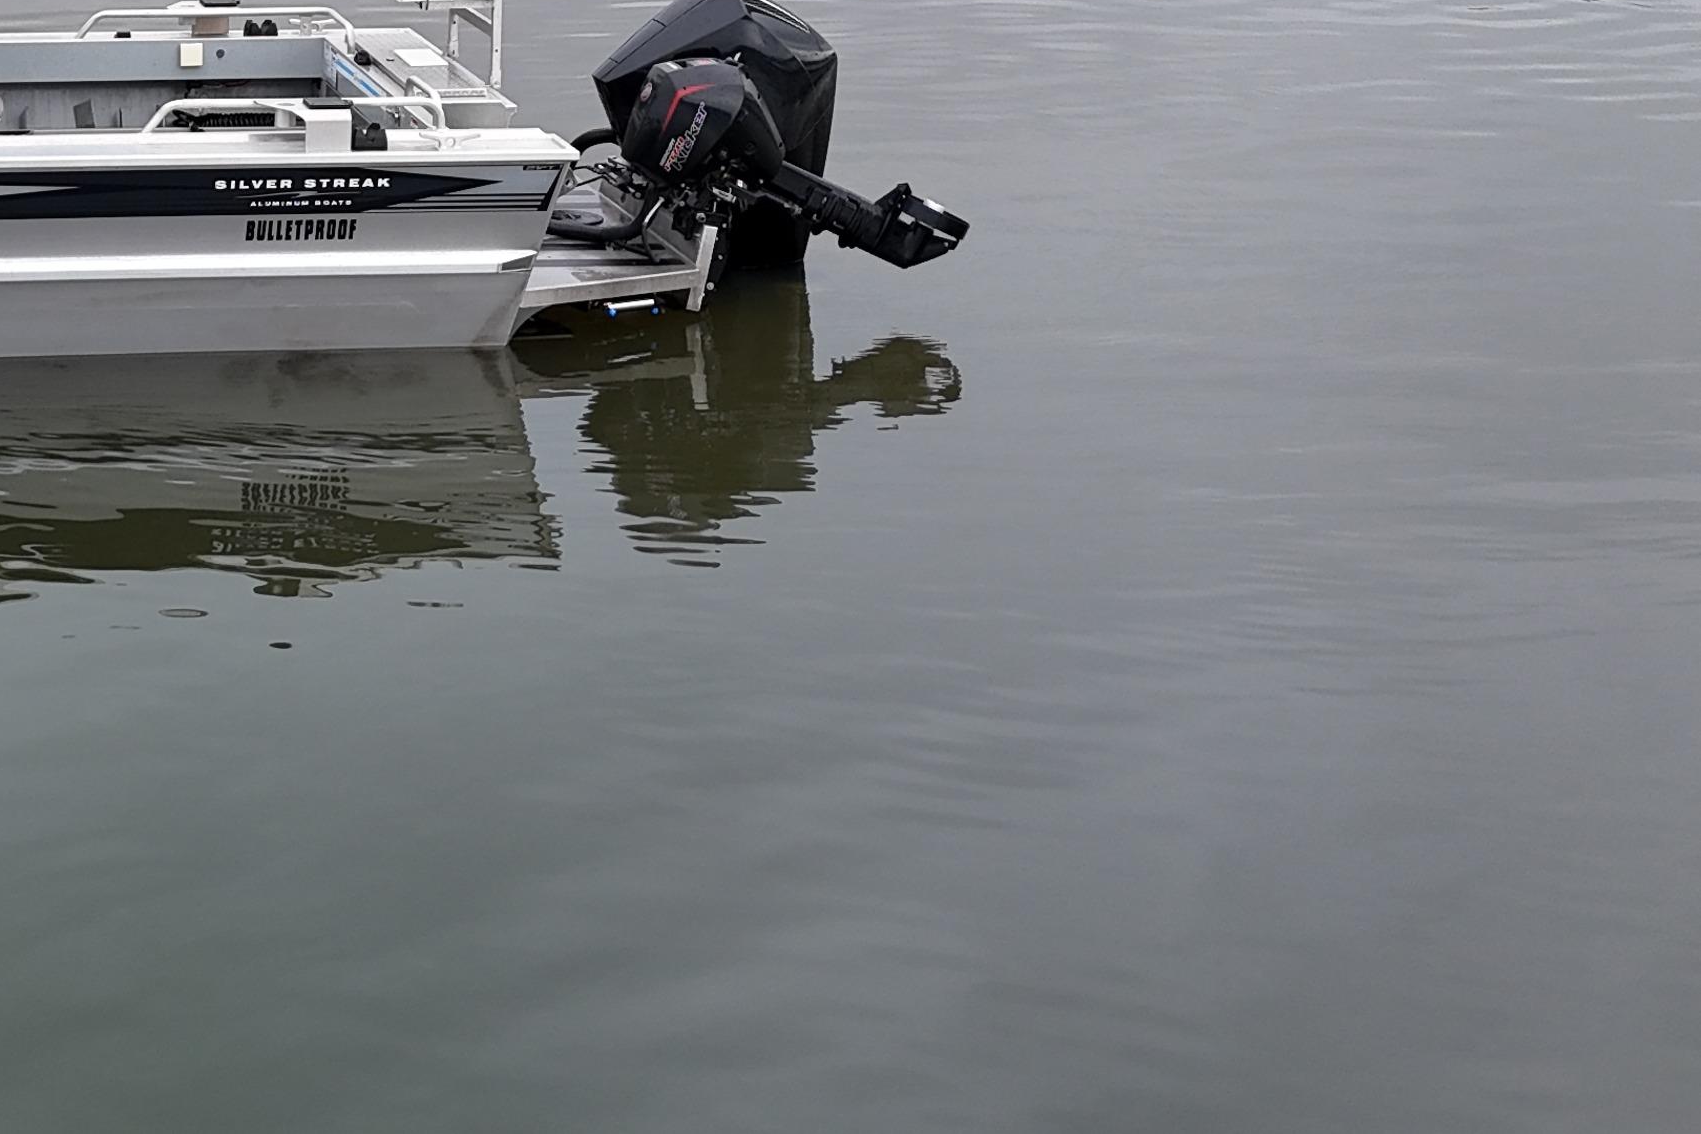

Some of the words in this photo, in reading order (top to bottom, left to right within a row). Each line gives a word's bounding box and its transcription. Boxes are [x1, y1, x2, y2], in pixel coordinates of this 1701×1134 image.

[215, 179, 293, 190] SILVER
[304, 178, 391, 188] STREAK
[245, 219, 357, 241] BULLETPROOF
